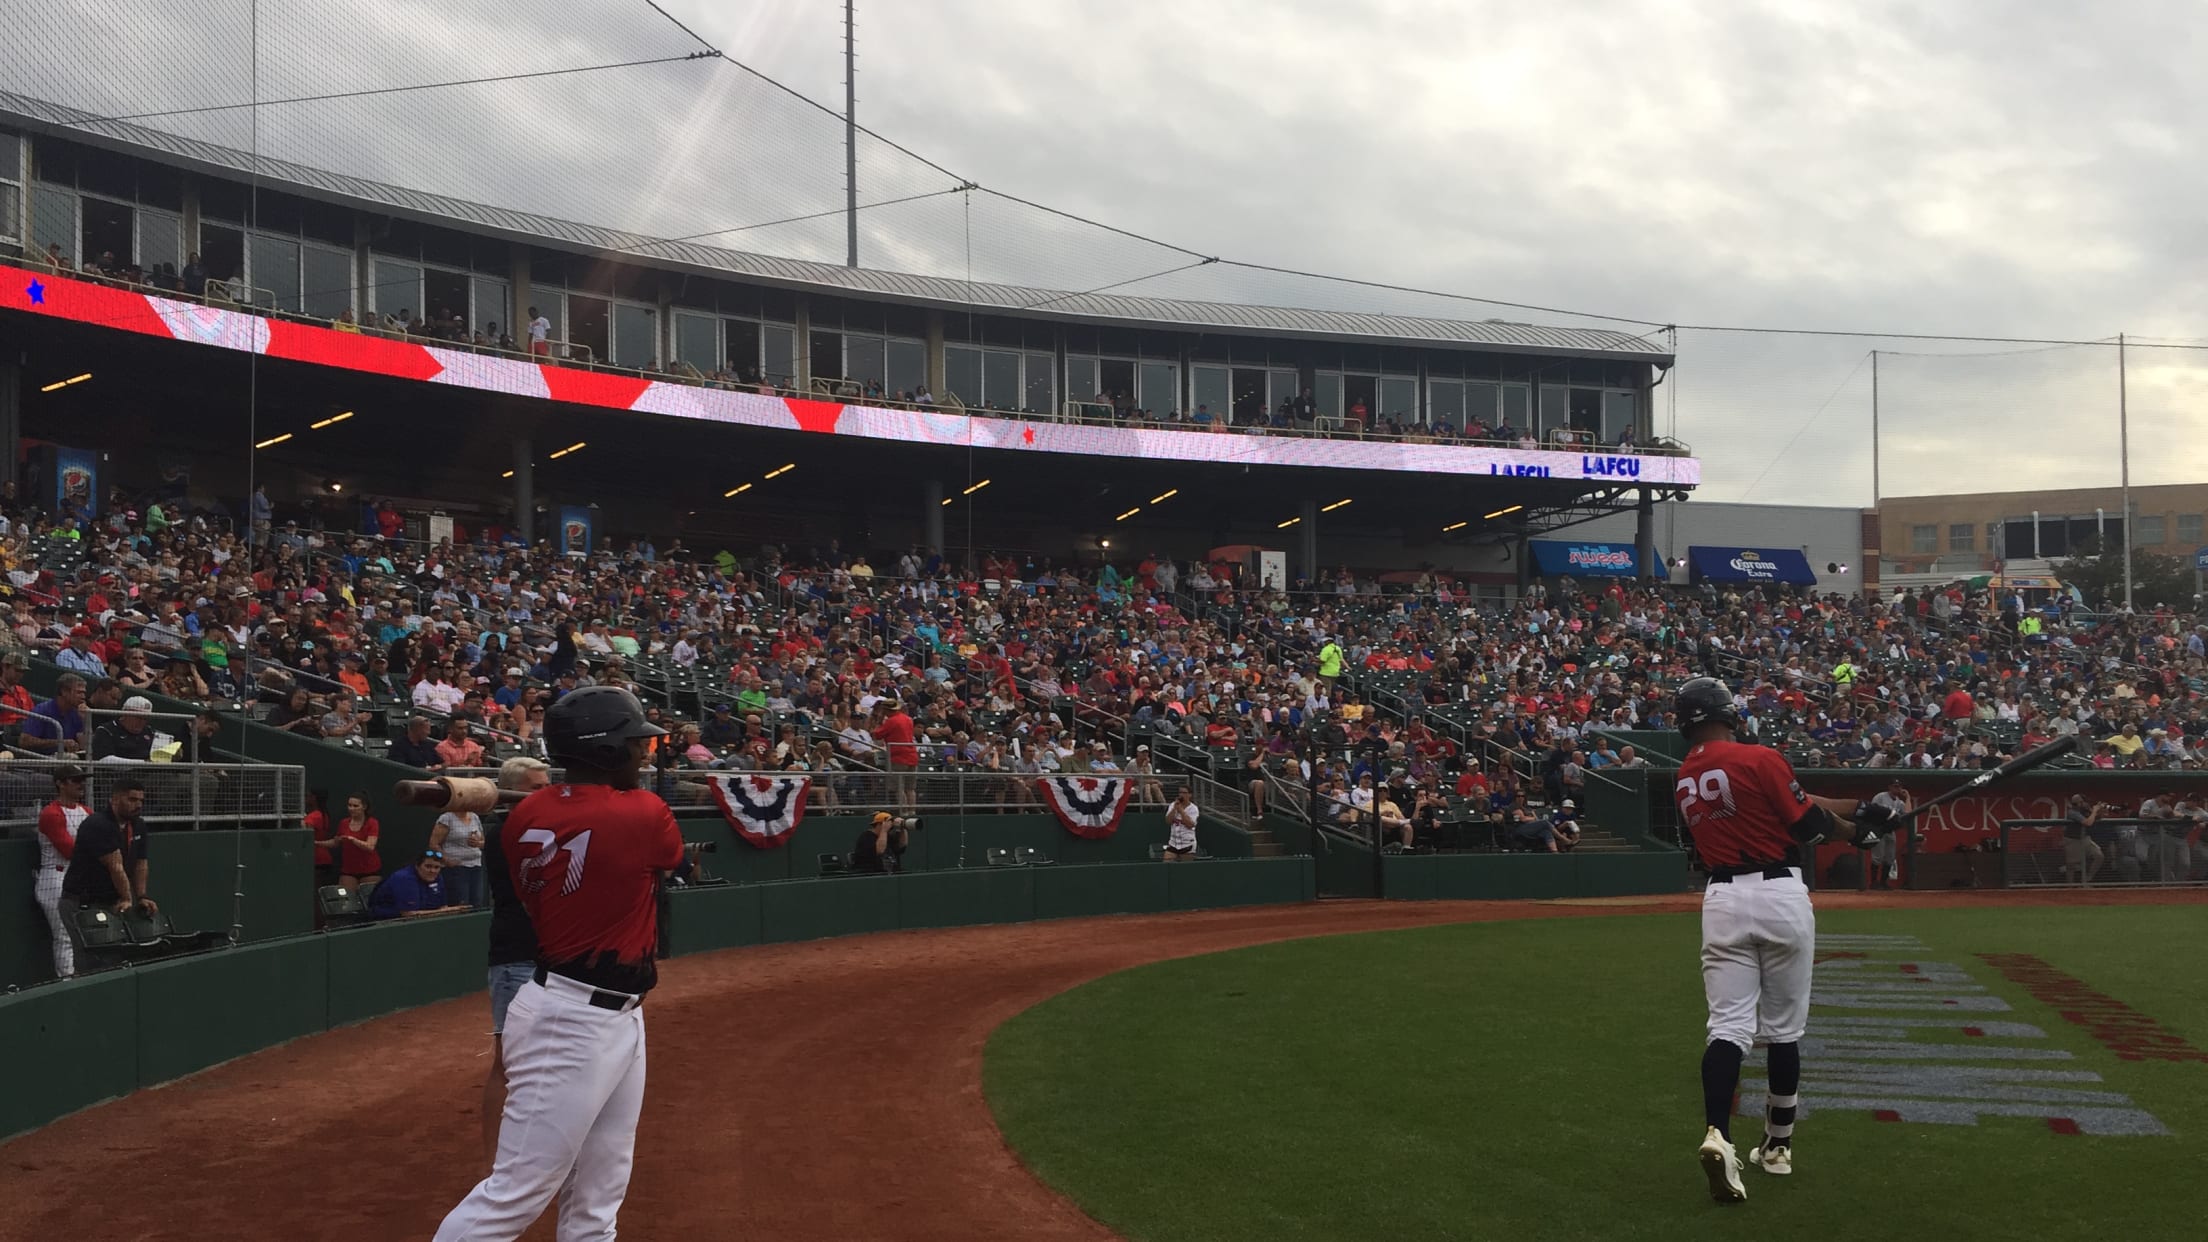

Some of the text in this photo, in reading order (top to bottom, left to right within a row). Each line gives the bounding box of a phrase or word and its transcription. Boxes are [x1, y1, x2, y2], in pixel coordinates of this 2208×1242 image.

[1583, 455, 1640, 477] LAFCU
[1730, 558, 1778, 571] Corona
[1676, 768, 1737, 827] 29
[1911, 796, 2069, 833] JACKSO
[518, 828, 592, 897] 21
